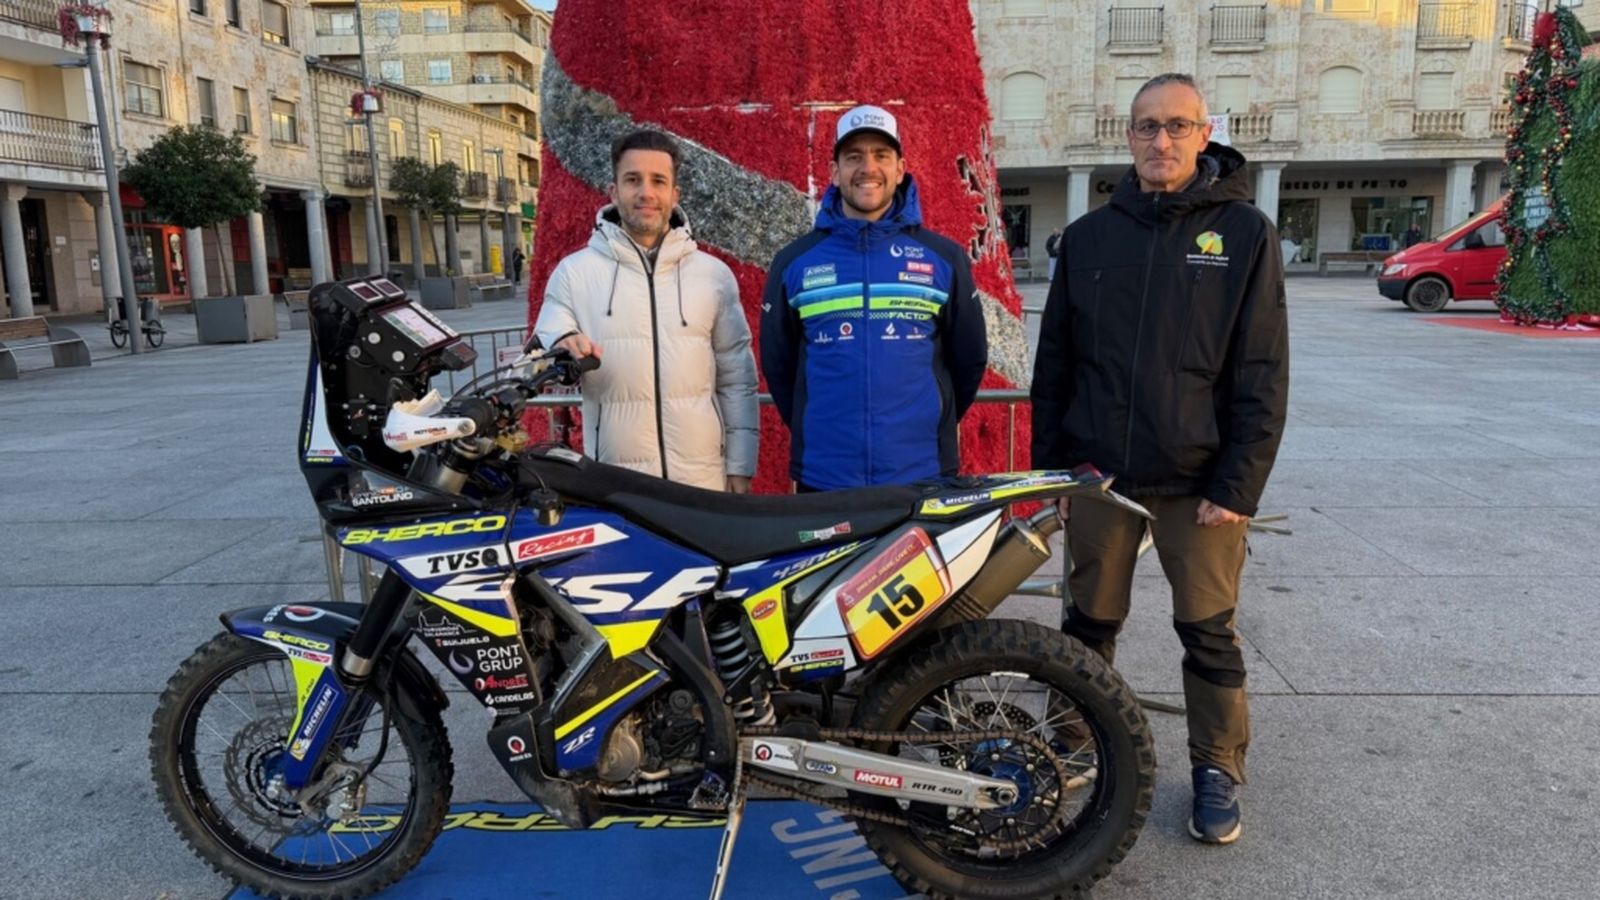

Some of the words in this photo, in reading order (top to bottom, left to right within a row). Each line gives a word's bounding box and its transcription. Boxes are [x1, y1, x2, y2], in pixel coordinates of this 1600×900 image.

[352, 491, 413, 507] SANTOLINO
[945, 492, 989, 504] MICHELIN
[342, 515, 507, 545] SHERCO
[427, 549, 480, 574] TVS
[519, 529, 592, 558] Racing
[866, 573, 925, 631] 15
[262, 630, 330, 651] SHERCO
[476, 644, 521, 660] PONT
[790, 653, 809, 662] TVS
[479, 657, 523, 673] GRUP
[494, 692, 534, 703] CANDELAS
[303, 688, 332, 737] MICHELIN
[562, 726, 596, 754] ZR
[856, 771, 900, 787] MOTUL
[911, 781, 937, 792] RTR
[938, 785, 963, 796] 450
